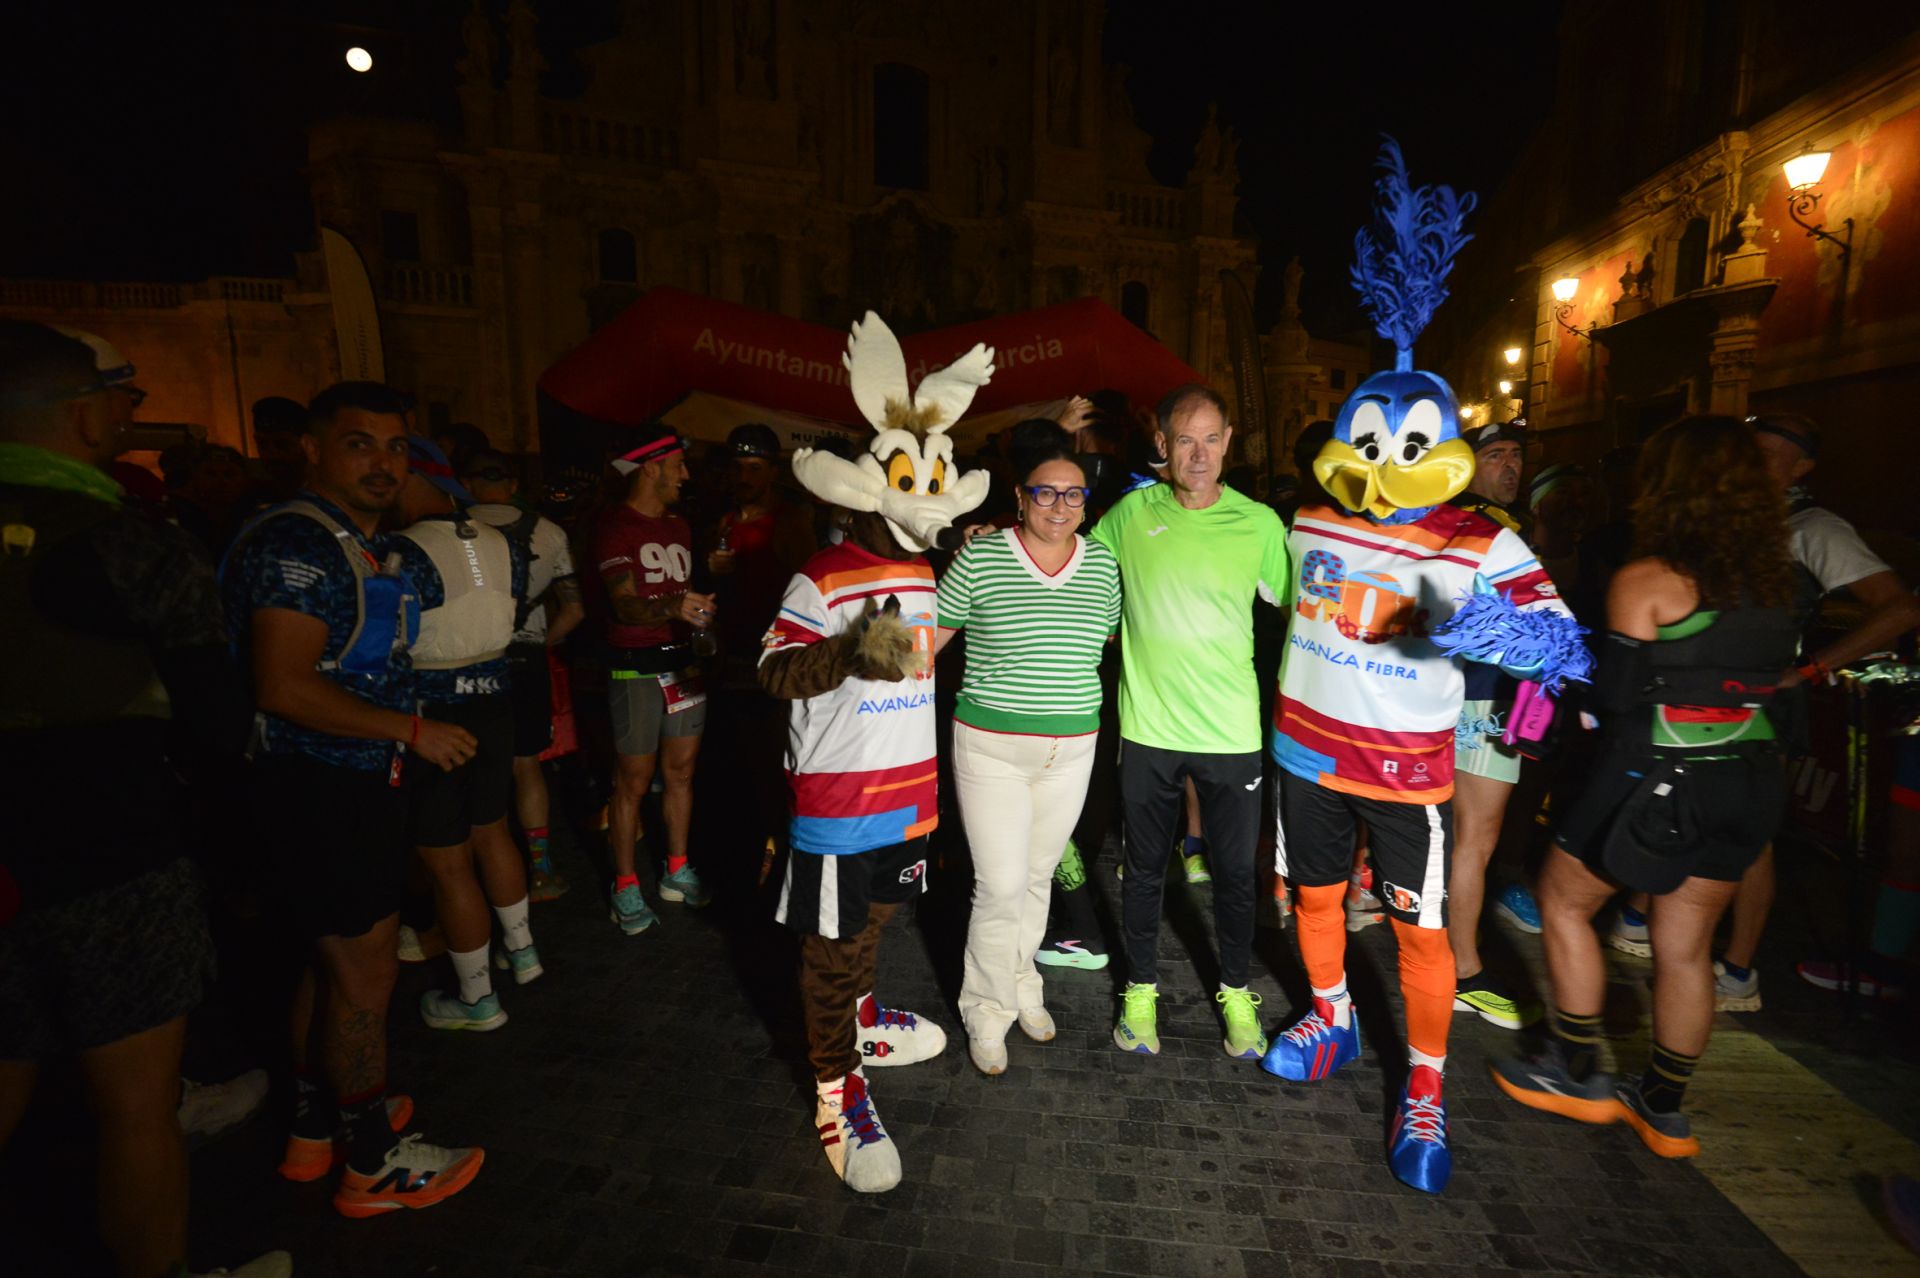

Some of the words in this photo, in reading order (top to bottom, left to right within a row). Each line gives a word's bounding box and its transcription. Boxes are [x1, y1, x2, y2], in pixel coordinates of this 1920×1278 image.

[692, 327, 850, 387] Ayuntami
[463, 540, 484, 586] KIPRUN
[640, 542, 692, 584] 90
[1291, 634, 1360, 669] AVANZA
[1365, 660, 1417, 681] FIBRA
[857, 693, 928, 714] AVANZA
